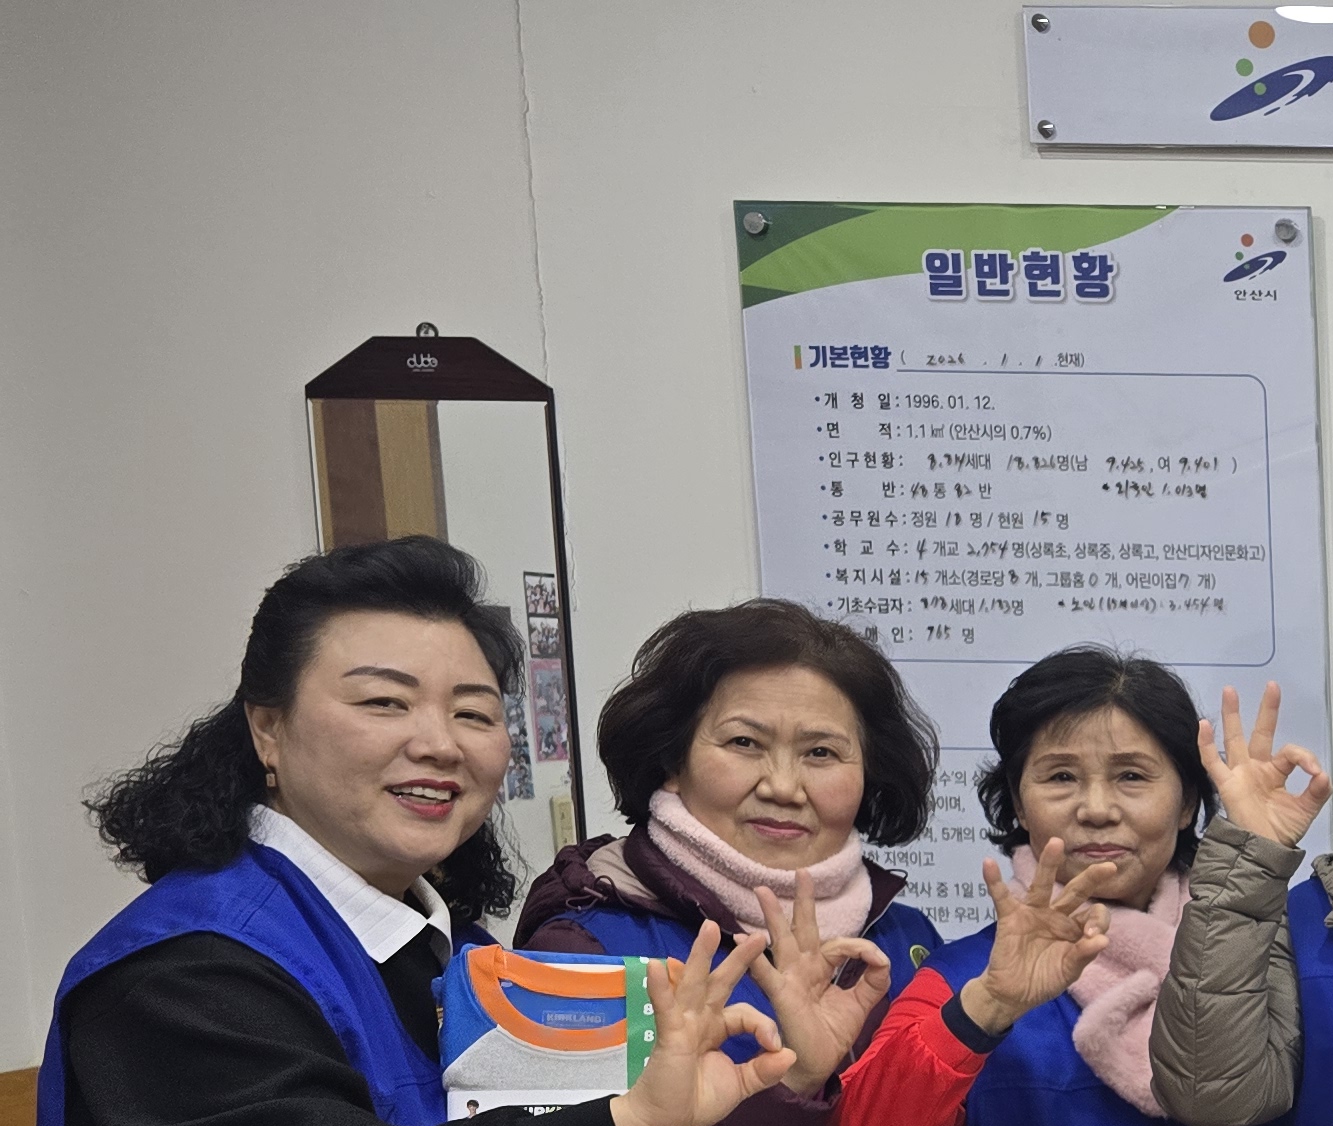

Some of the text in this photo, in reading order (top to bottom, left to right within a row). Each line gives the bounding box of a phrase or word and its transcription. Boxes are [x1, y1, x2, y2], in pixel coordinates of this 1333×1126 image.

[925, 251, 1116, 298] 일반현황
[1234, 289, 1277, 301] 안산시
[809, 345, 891, 369] 기본현황
[905, 395, 995, 410] 1996. 01. 12.
[950, 426, 1006, 440] (안산시의
[1011, 426, 1052, 440] 0.7%)
